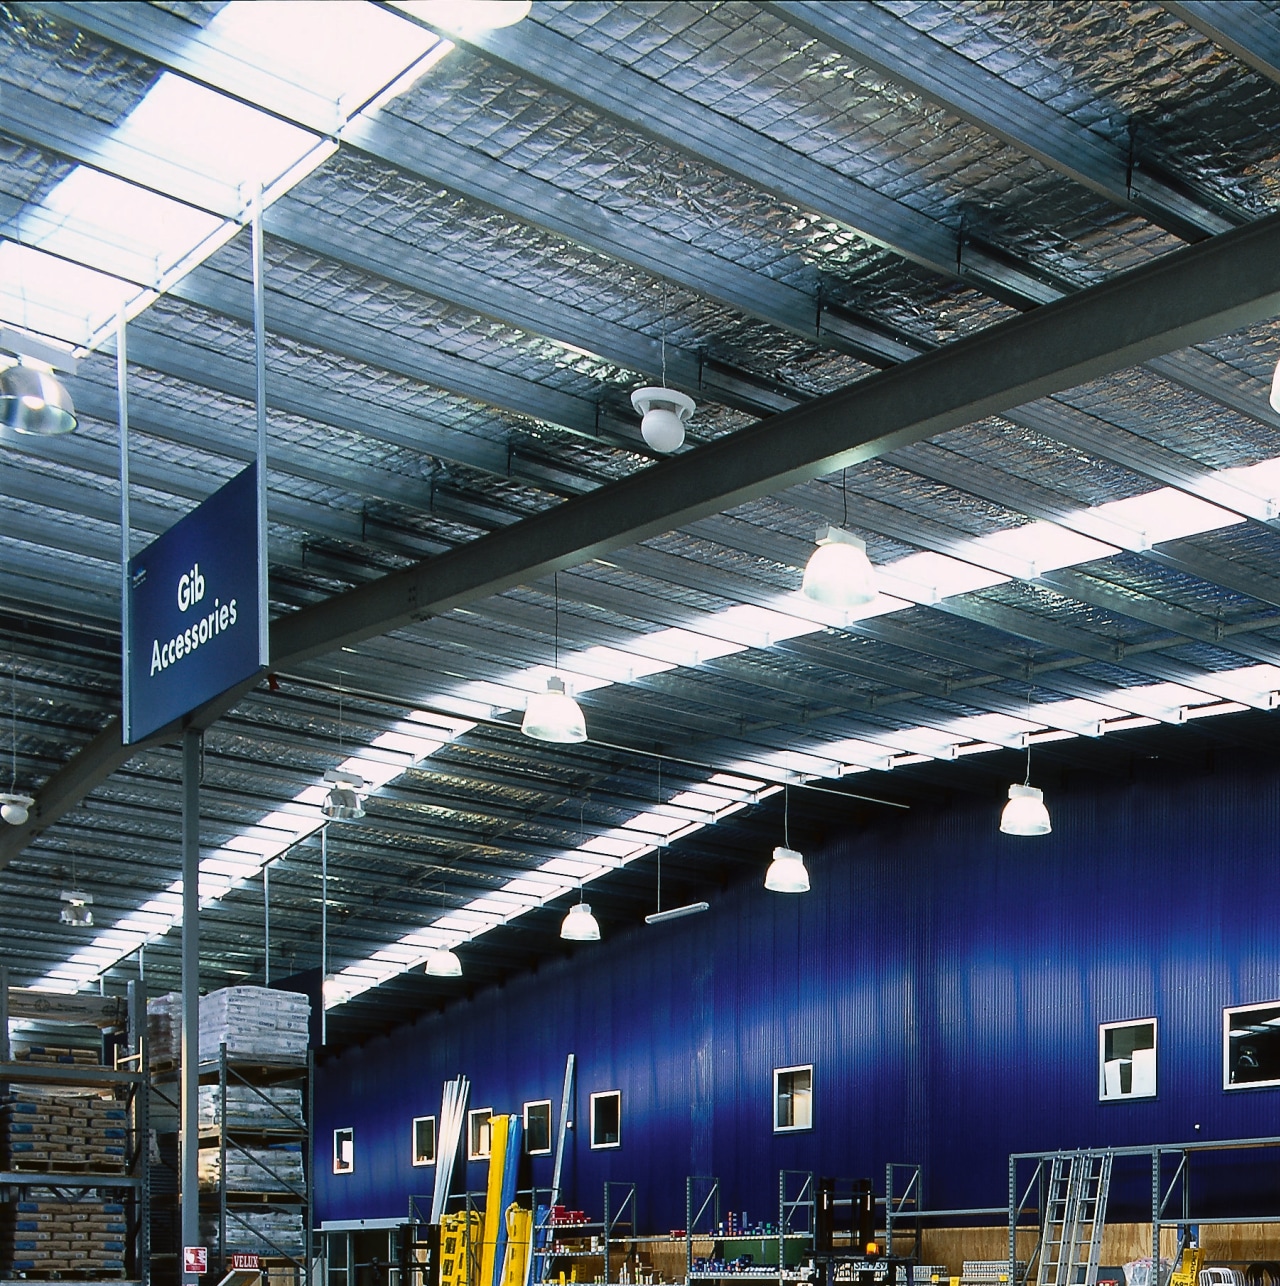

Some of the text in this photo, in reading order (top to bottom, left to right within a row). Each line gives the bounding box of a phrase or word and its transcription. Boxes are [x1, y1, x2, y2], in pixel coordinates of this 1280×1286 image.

[177, 563, 205, 612] Gib
[150, 598, 237, 676] Accessories
[233, 1255, 259, 1268] VELUX
